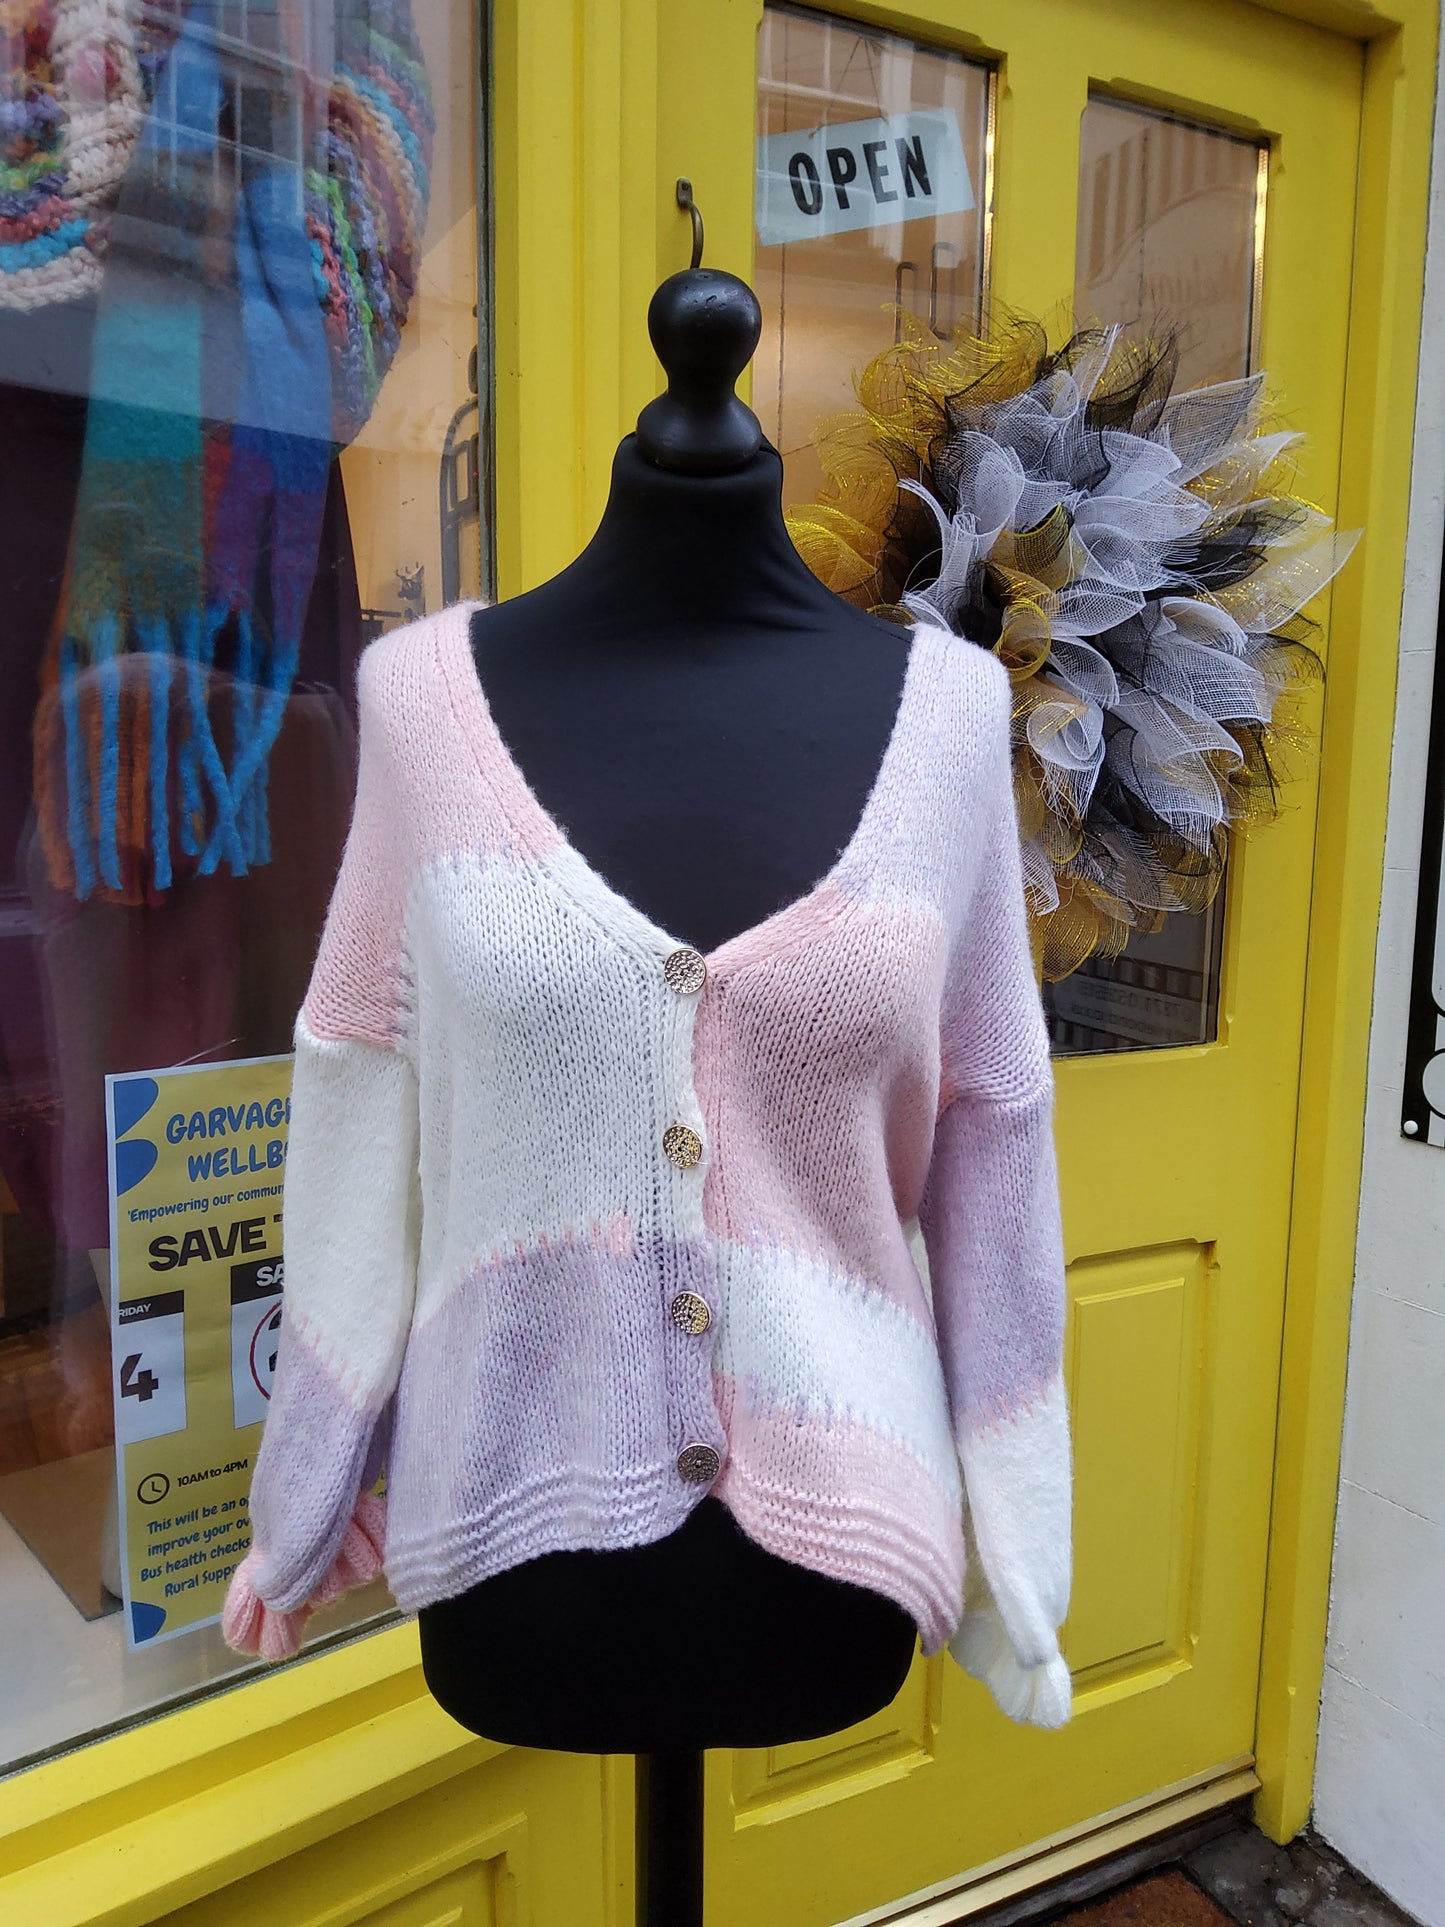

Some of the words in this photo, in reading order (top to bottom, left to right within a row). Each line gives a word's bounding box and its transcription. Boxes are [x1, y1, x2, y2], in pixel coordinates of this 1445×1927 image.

[788, 135, 932, 215] OPEN
[187, 1139, 288, 1182] WELLB
[212, 1194, 234, 1206] our
[148, 1217, 266, 1272] SAVE
[120, 1353, 159, 1402] 4
[177, 1470, 208, 1487] 10AM
[210, 1468, 221, 1478] to
[223, 1459, 248, 1473] 4PM
[147, 1518, 171, 1534] This
[175, 1509, 198, 1526] will
[202, 1505, 218, 1518] be
[221, 1500, 236, 1512] an
[148, 1531, 200, 1556] improve
[203, 1522, 233, 1543] your
[140, 1565, 162, 1582] Bus
[166, 1551, 206, 1574] health
[210, 1537, 251, 1559] checks
[165, 1574, 199, 1597] Rural
